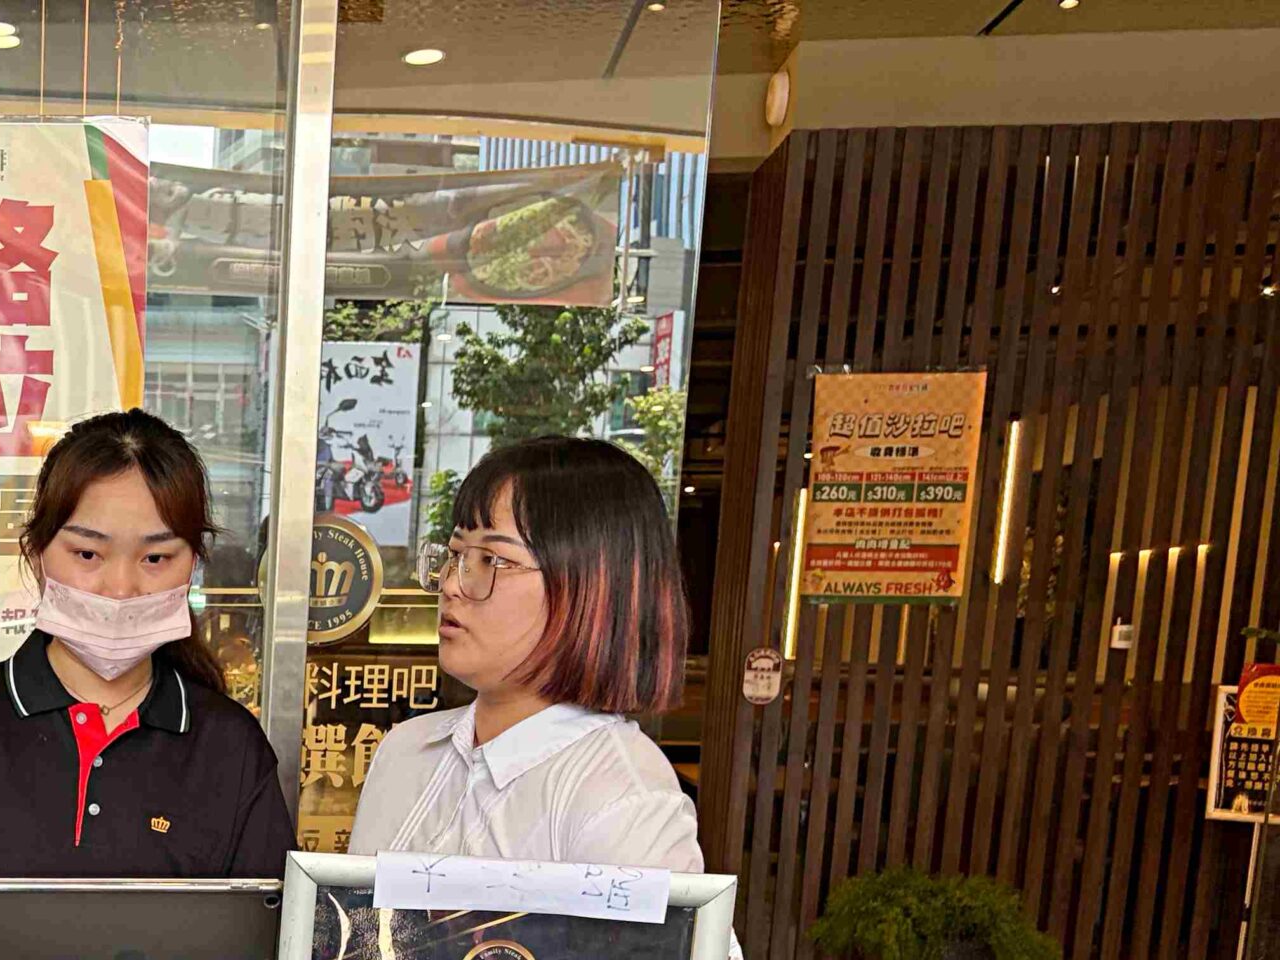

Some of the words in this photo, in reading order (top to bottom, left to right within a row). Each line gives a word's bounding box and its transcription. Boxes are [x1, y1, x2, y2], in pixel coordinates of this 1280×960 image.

[828, 412, 967, 439] 超值沙拉吧
[815, 486, 857, 500] $260元
[867, 486, 906, 500] $310元
[920, 486, 962, 500] $390元
[327, 529, 356, 549] Steak
[354, 548, 368, 581] House
[823, 582, 882, 594] ALWAYS
[885, 582, 933, 595] FRESH
[327, 609, 353, 629] 1995
[304, 662, 439, 710] 料理吧
